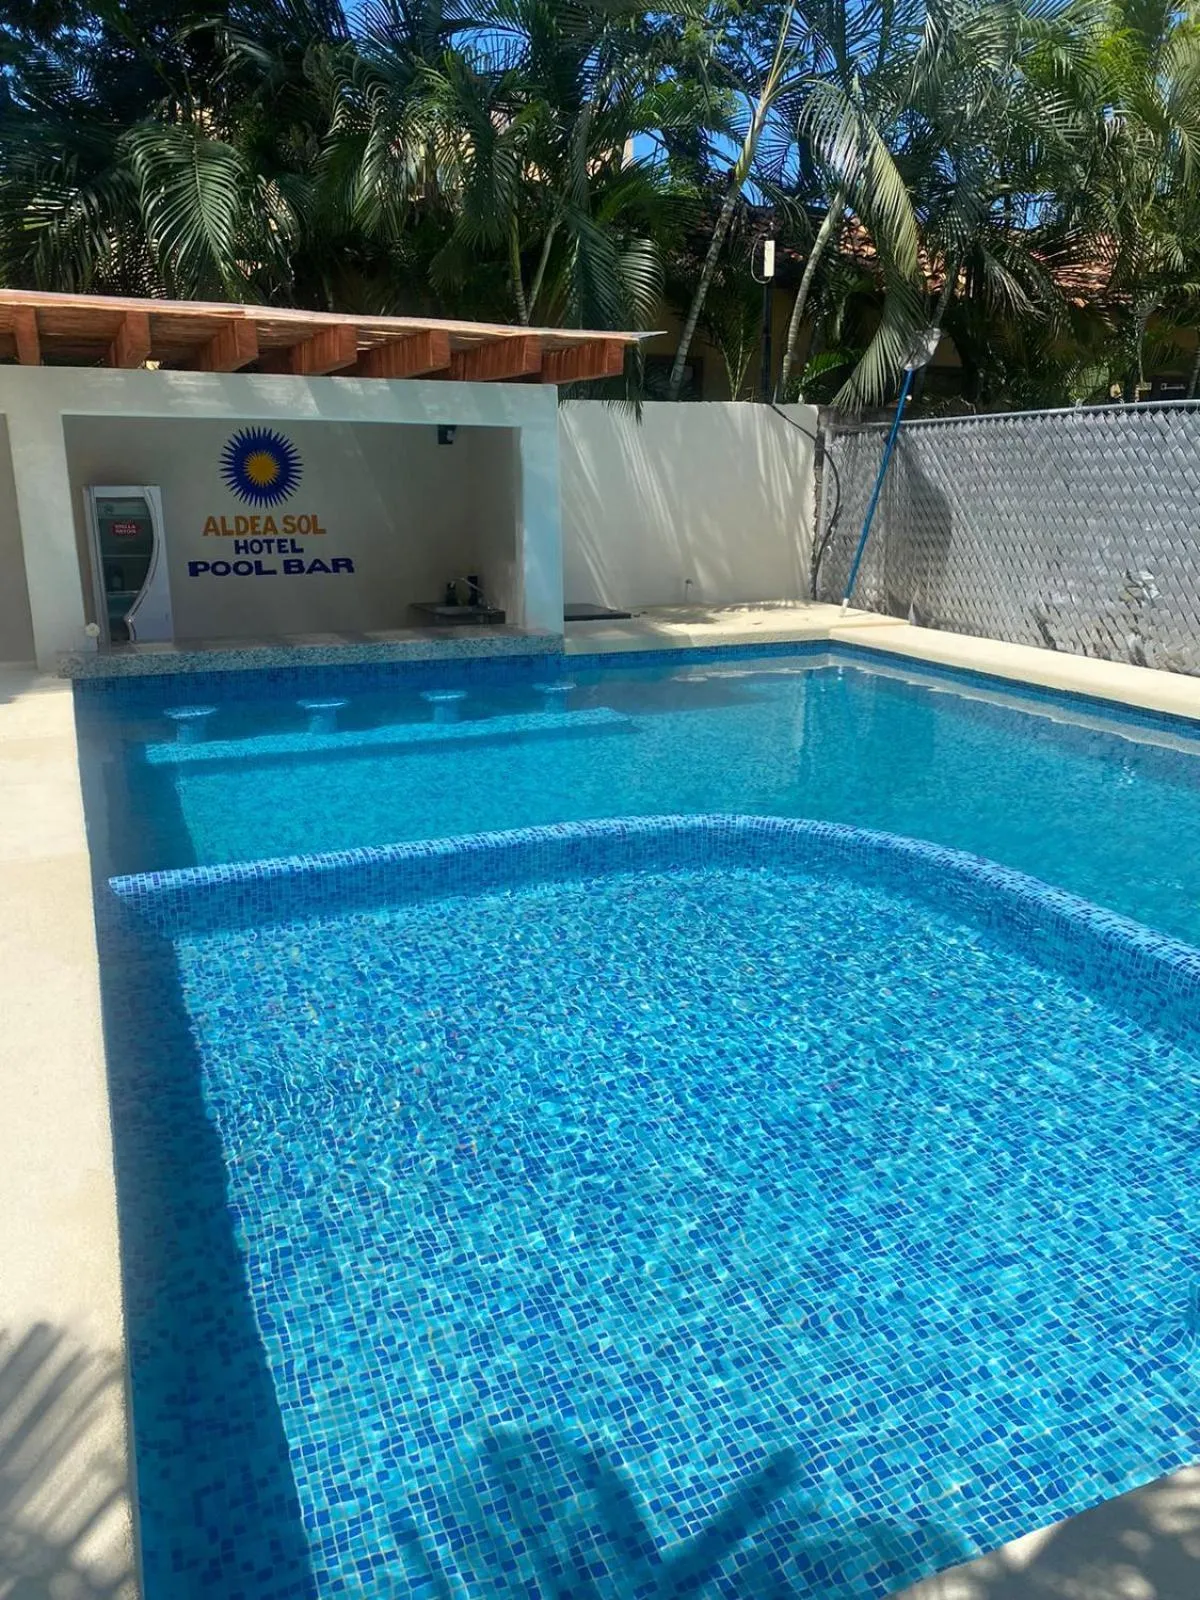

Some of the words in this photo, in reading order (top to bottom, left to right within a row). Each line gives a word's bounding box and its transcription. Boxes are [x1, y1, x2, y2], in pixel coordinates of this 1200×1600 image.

[203, 515, 278, 536] ALDEA
[283, 514, 326, 535] SOL
[234, 538, 304, 554] HOTEL
[188, 560, 277, 577] POOL
[283, 558, 355, 575] BAR
